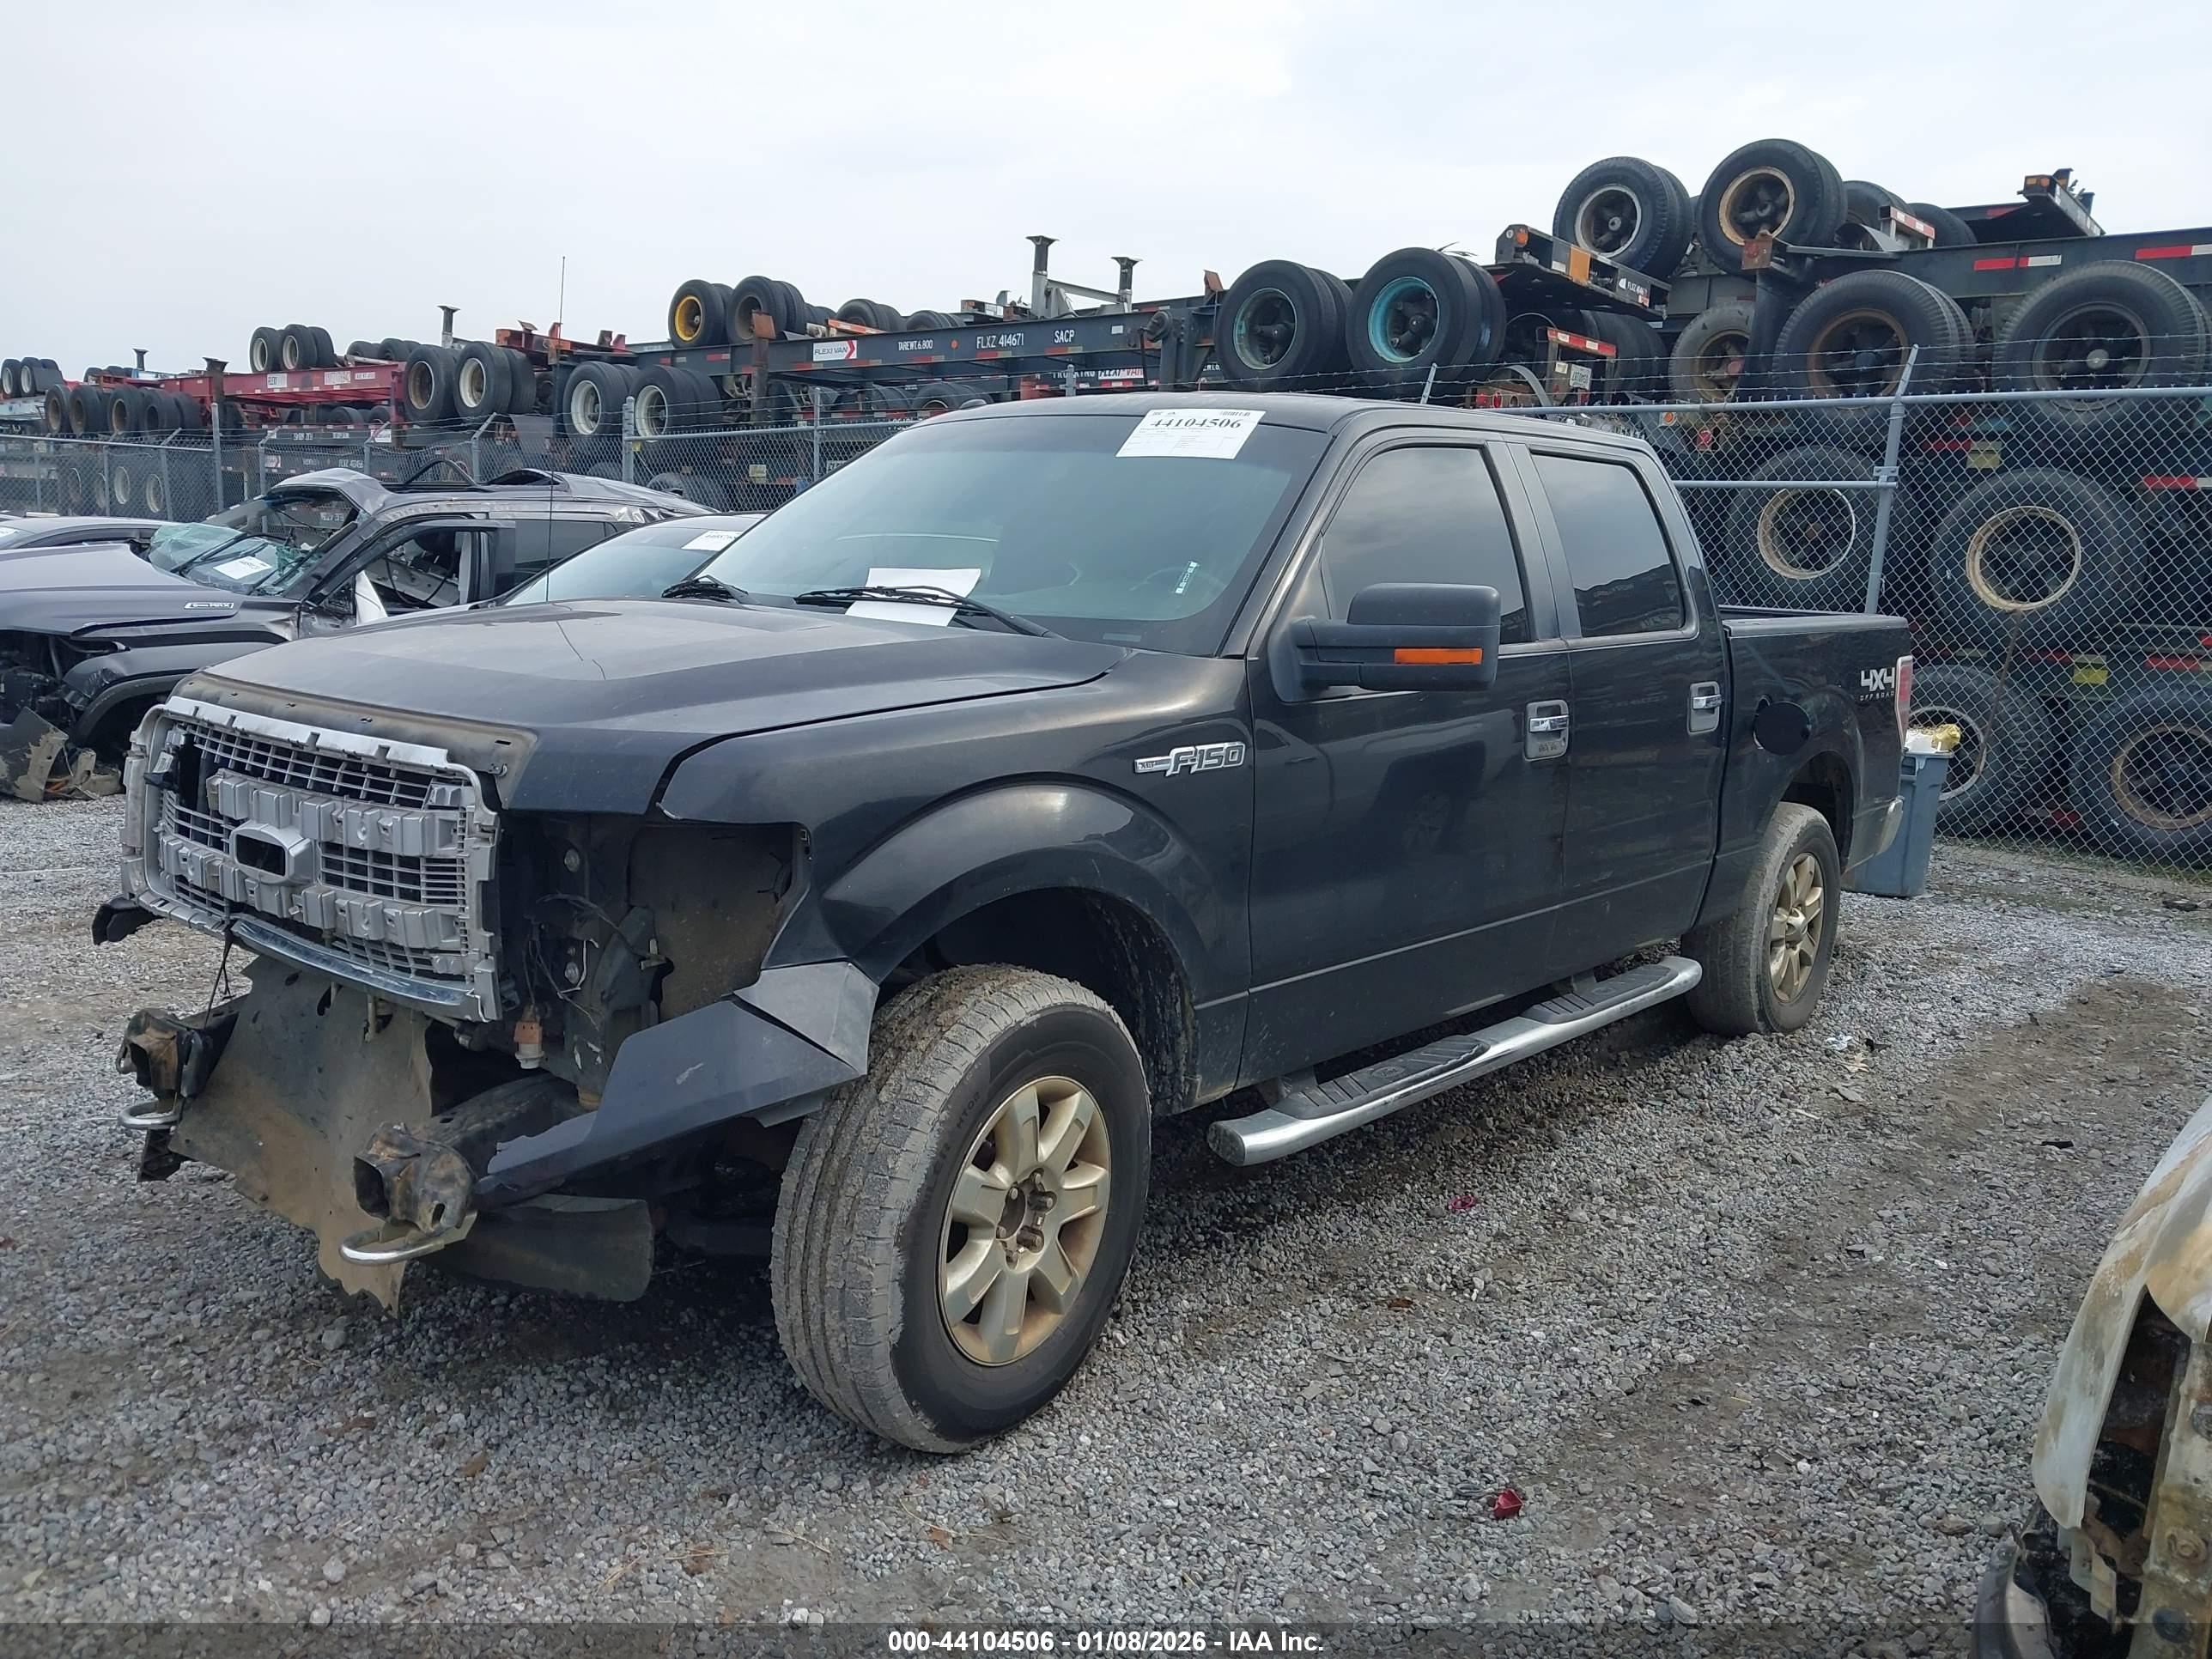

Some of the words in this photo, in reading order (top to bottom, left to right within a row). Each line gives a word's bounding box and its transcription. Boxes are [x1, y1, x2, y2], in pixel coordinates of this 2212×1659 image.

[976, 335, 997, 349] FLXZ
[998, 332, 1024, 347] 414671
[1054, 329, 1075, 343] SACP
[1150, 418, 1243, 428] 44104506
[1138, 760, 1156, 770] XLT
[1165, 741, 1246, 777] F-150
